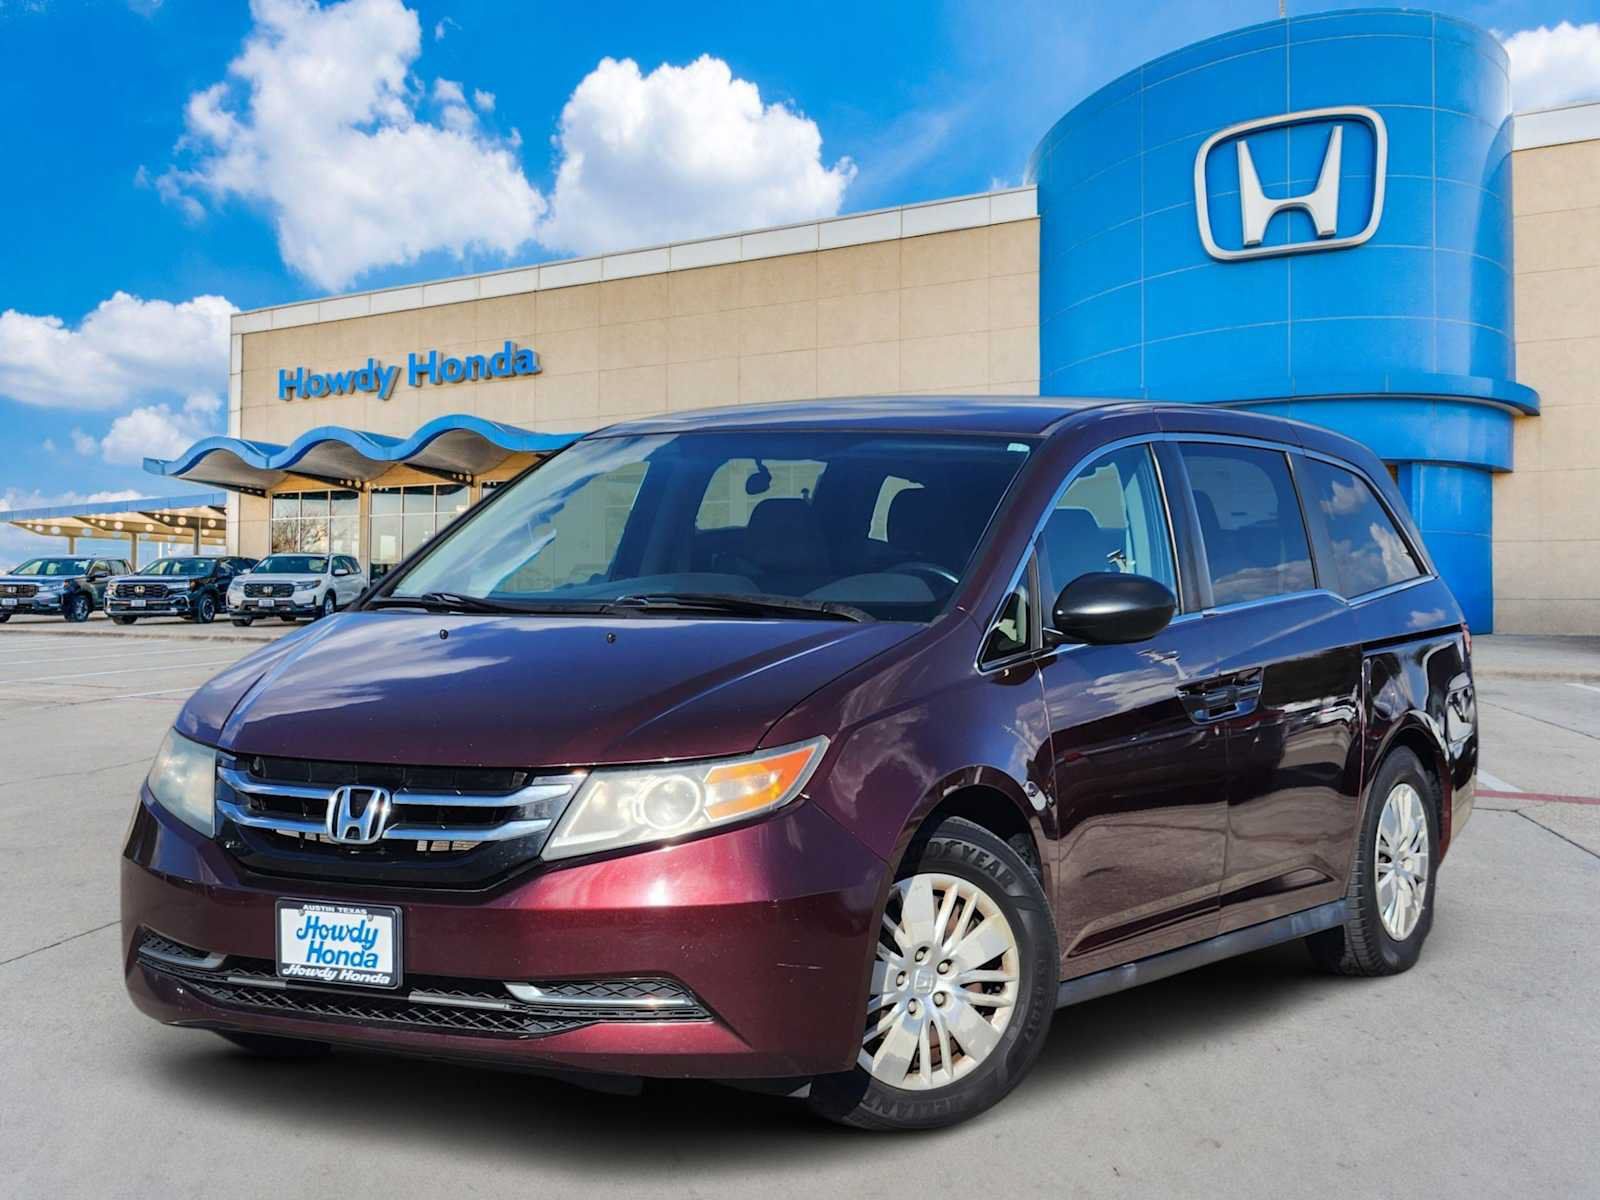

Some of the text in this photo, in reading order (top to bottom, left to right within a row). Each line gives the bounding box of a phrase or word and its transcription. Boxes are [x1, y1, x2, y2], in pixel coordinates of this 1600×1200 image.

[278, 340, 542, 401] Howdy Honda
[302, 904, 368, 914] AUSTIN TEXAS
[296, 915, 379, 950] Howdy
[306, 940, 379, 968] Honda
[282, 964, 391, 984] Howdy Honda
